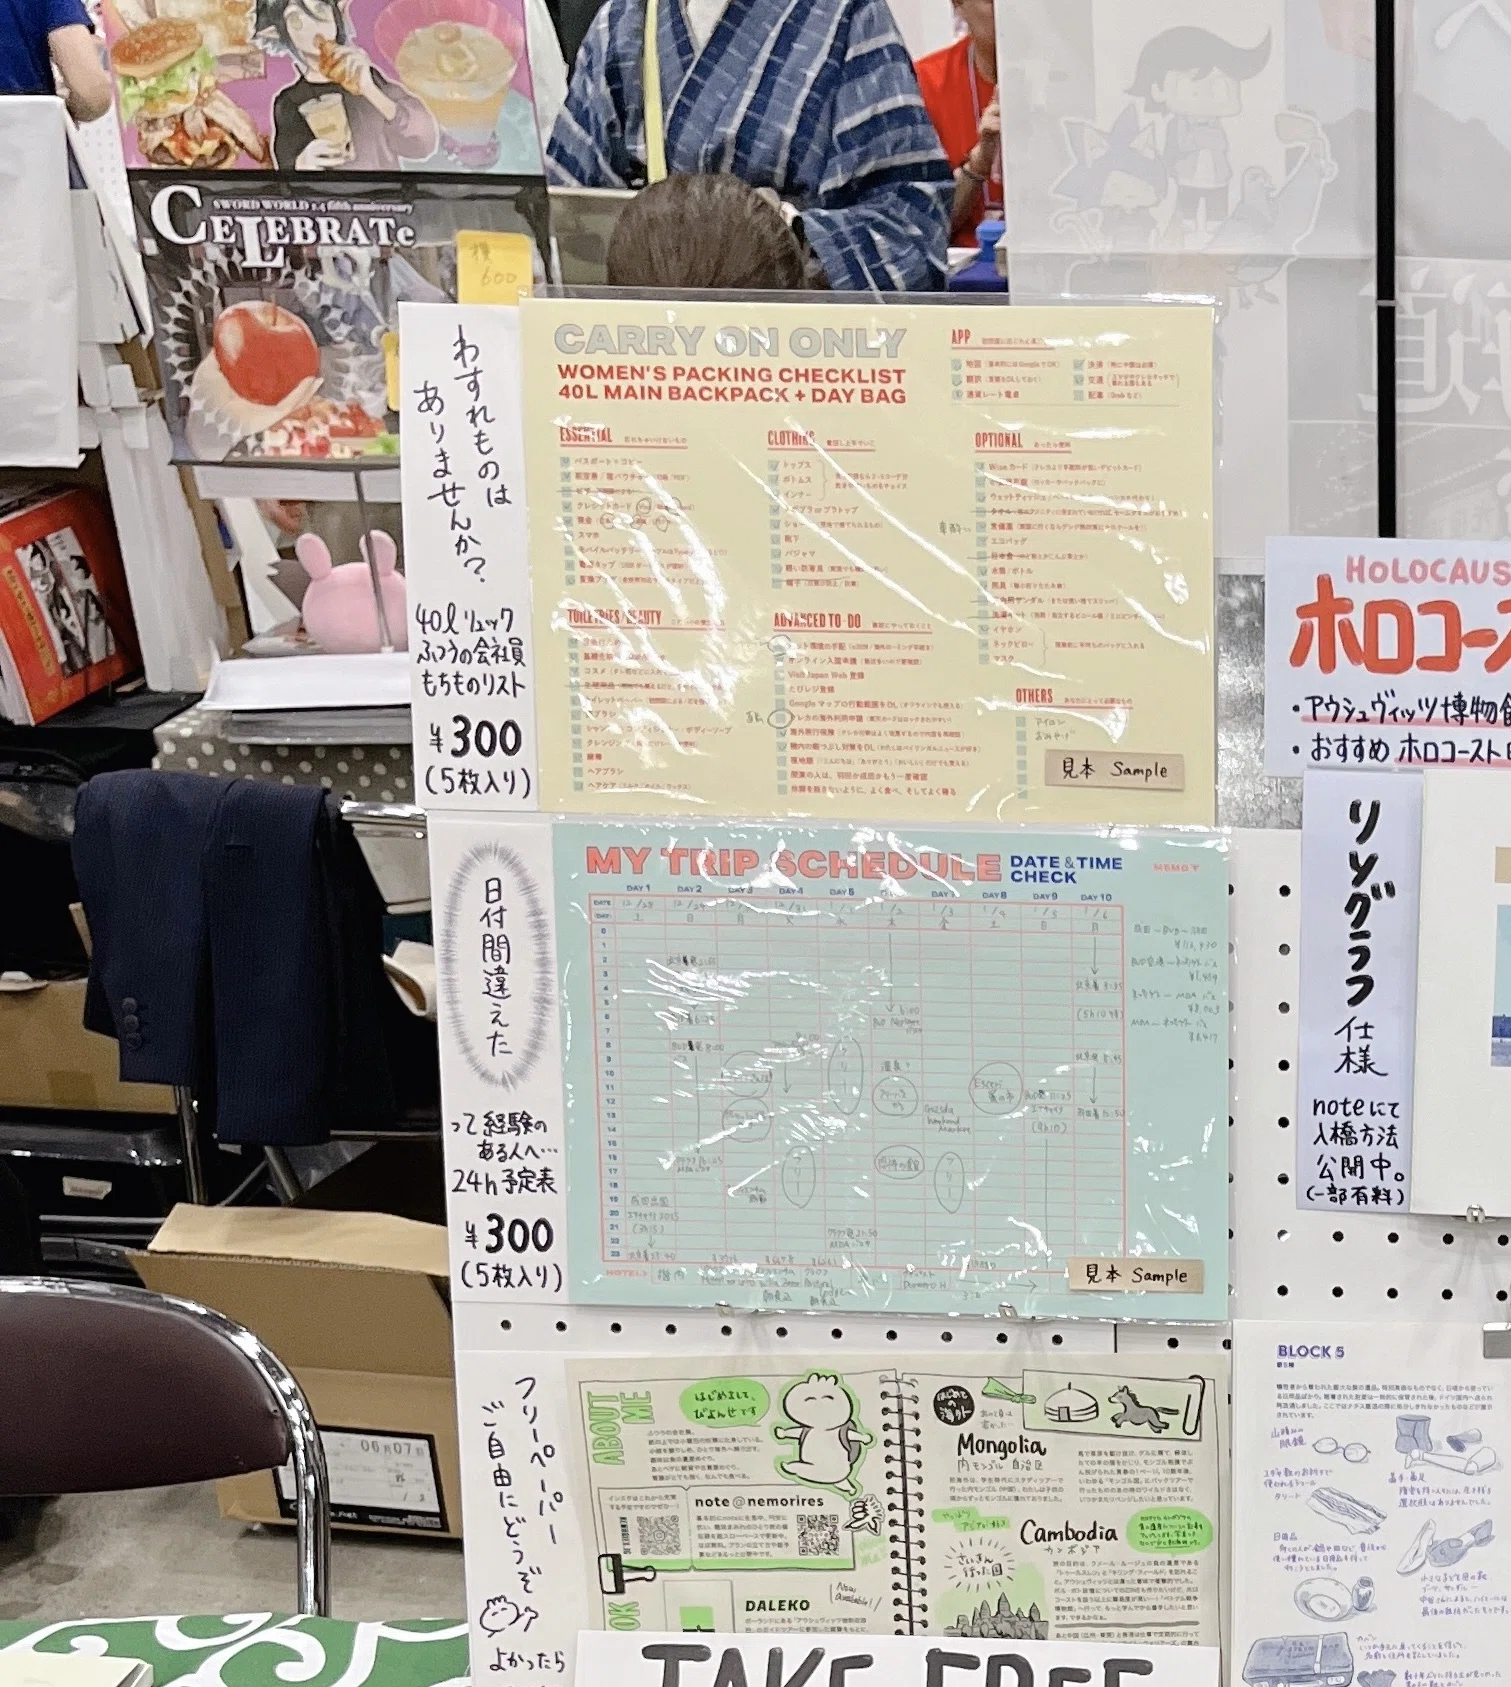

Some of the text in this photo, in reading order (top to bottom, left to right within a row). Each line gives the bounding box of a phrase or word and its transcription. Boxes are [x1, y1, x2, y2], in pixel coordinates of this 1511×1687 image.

[262, 200, 309, 211] WORLD
[553, 322, 908, 360] CARRY ON ONLY
[951, 329, 972, 345] APP
[557, 364, 907, 386] WOMEN'S PACKING CHECKLIST
[558, 385, 599, 401] 40L
[603, 386, 665, 402] MAIN
[669, 387, 789, 404] BACKPACK
[811, 389, 857, 405] DAY
[860, 390, 907, 406] BAG
[453, 324, 512, 507] わすれものは
[975, 432, 1024, 448] OPTIONAL
[416, 637, 527, 668] ふつうの会社員
[421, 671, 527, 698] もちものリスト
[1015, 688, 1054, 704] OTHERS
[429, 715, 523, 758] ¥300
[1062, 756, 1169, 782] 見本 Sample
[586, 846, 1003, 882] MY TRIP SCHEDULE
[1010, 855, 1062, 870] DATE
[1078, 857, 1124, 871] TIME
[627, 884, 645, 892] DAY
[677, 885, 694, 893] DAY
[1010, 870, 1078, 885] CHECK
[830, 888, 847, 896] DAY
[982, 891, 999, 900] DAY
[1033, 892, 1050, 901] DAY
[1081, 893, 1113, 902] DAY 10
[480, 878, 513, 1057] 日付間違えた
[451, 1112, 549, 1138] って経験の
[1316, 1152, 1406, 1182] 公開中。
[464, 1211, 554, 1255] ¥300
[1085, 1264, 1188, 1286] 見本 Sample
[1278, 1344, 1332, 1359] BLOCK
[620, 1389, 656, 1424] ME
[587, 1391, 626, 1466] ABOUT
[957, 1432, 1048, 1461] Mongolia
[514, 1375, 565, 1545] フリーペーパー
[482, 1400, 544, 1595] ご自由にどうぞ
[695, 1495, 730, 1508] note
[1019, 1518, 1119, 1546] Cambodia
[745, 1599, 811, 1612] DALEKO
[489, 1649, 566, 1673] よかったら
